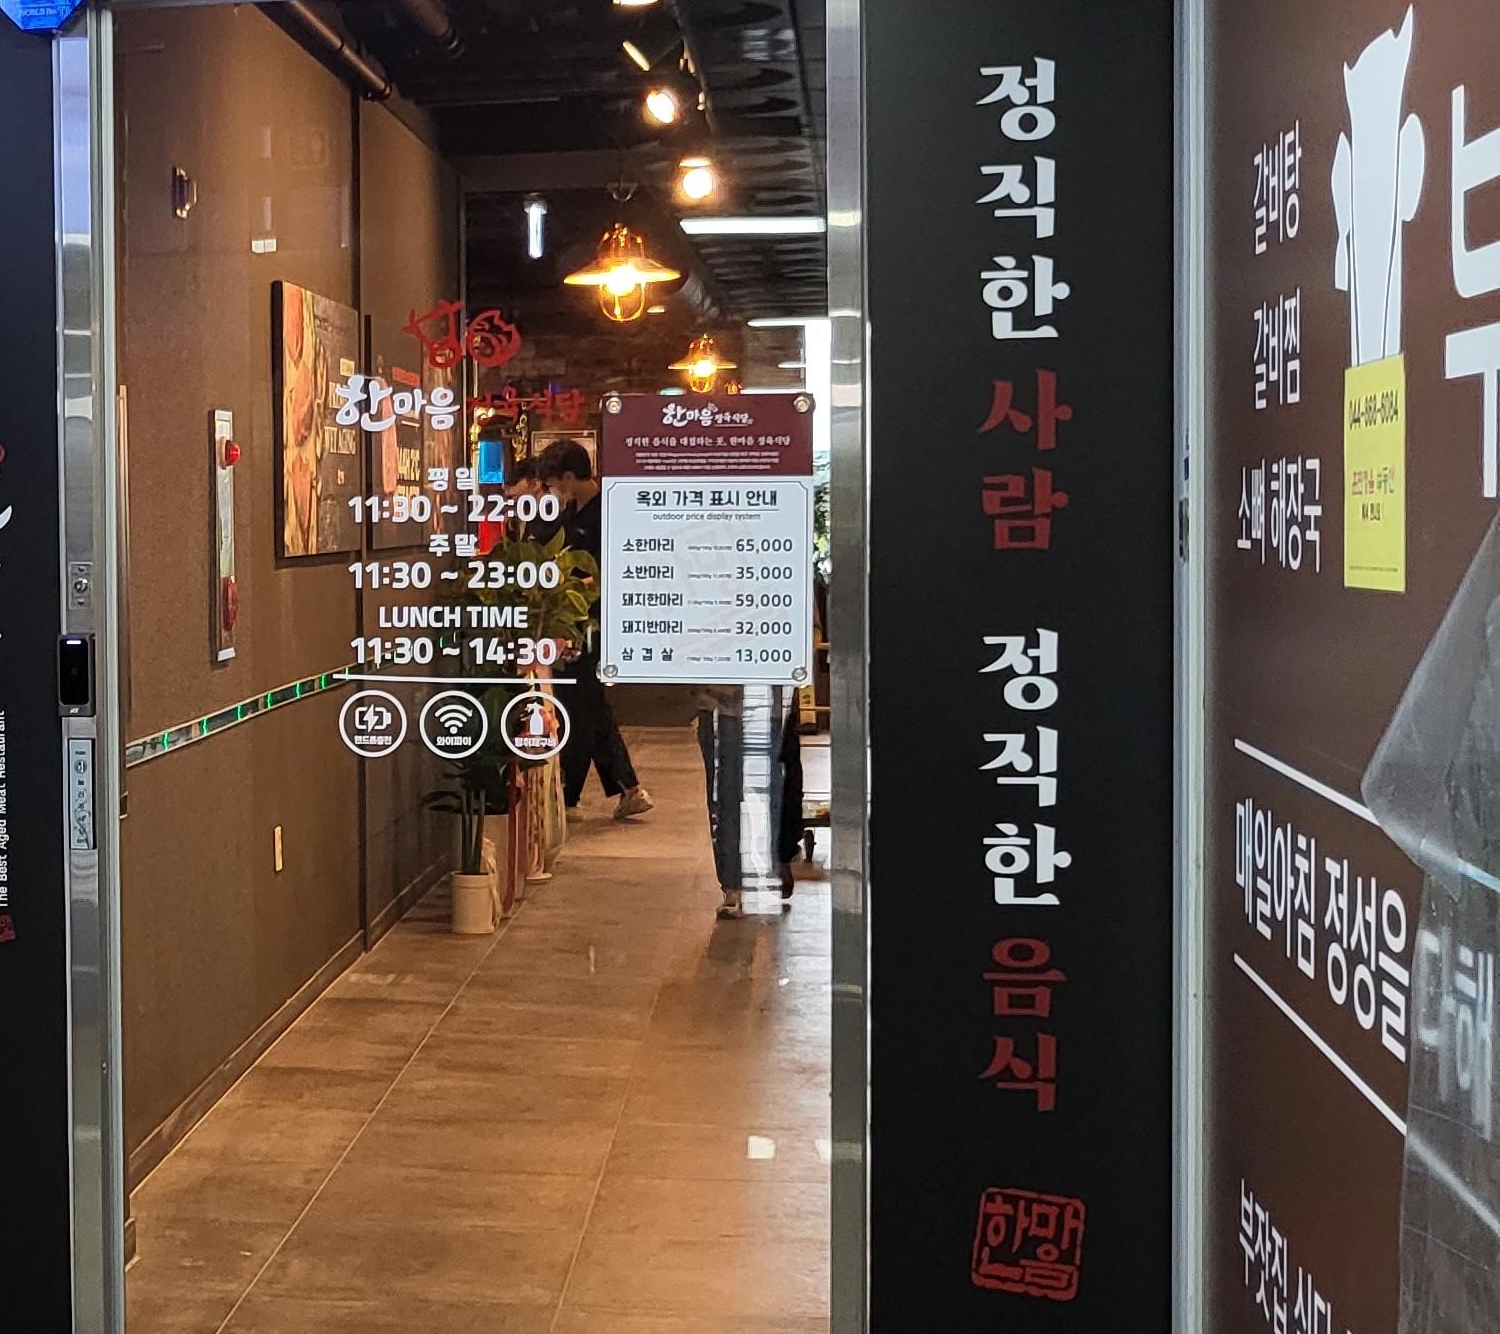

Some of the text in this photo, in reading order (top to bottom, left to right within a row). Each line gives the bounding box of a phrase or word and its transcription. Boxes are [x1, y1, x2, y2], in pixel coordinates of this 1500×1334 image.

[1252, 120, 1302, 255] 갈비탕
[1252, 286, 1301, 411] 갈비찜
[335, 374, 460, 432] 한마음
[662, 402, 713, 427] 한마음
[348, 496, 431, 523] 11:30
[467, 495, 560, 523] 22:00
[636, 490, 778, 507] 옥외 가격 표시 안내
[685, 513, 705, 521] price
[706, 512, 733, 522] display
[734, 513, 761, 521] system
[1237, 455, 1323, 574] 소뼈 해장국
[622, 538, 793, 555] 소한마리 65,000
[348, 561, 431, 589] 11:30
[467, 561, 560, 589] 23:00
[622, 565, 793, 582] 소반마리 35,000
[975, 56, 1073, 1113] 정직한 사람 정직한 음식
[621, 593, 793, 609] 돼지한마리 59,000
[379, 606, 528, 628] LUNCH TIME
[621, 620, 792, 637] 돼지반마리 32,000
[350, 637, 434, 665] 11:30
[468, 637, 557, 665] 14:30
[735, 649, 792, 664] 13,000
[436, 736, 471, 747] 와이파이
[1235, 797, 1316, 981] 매일아침
[1324, 858, 1410, 1064] 정성을
